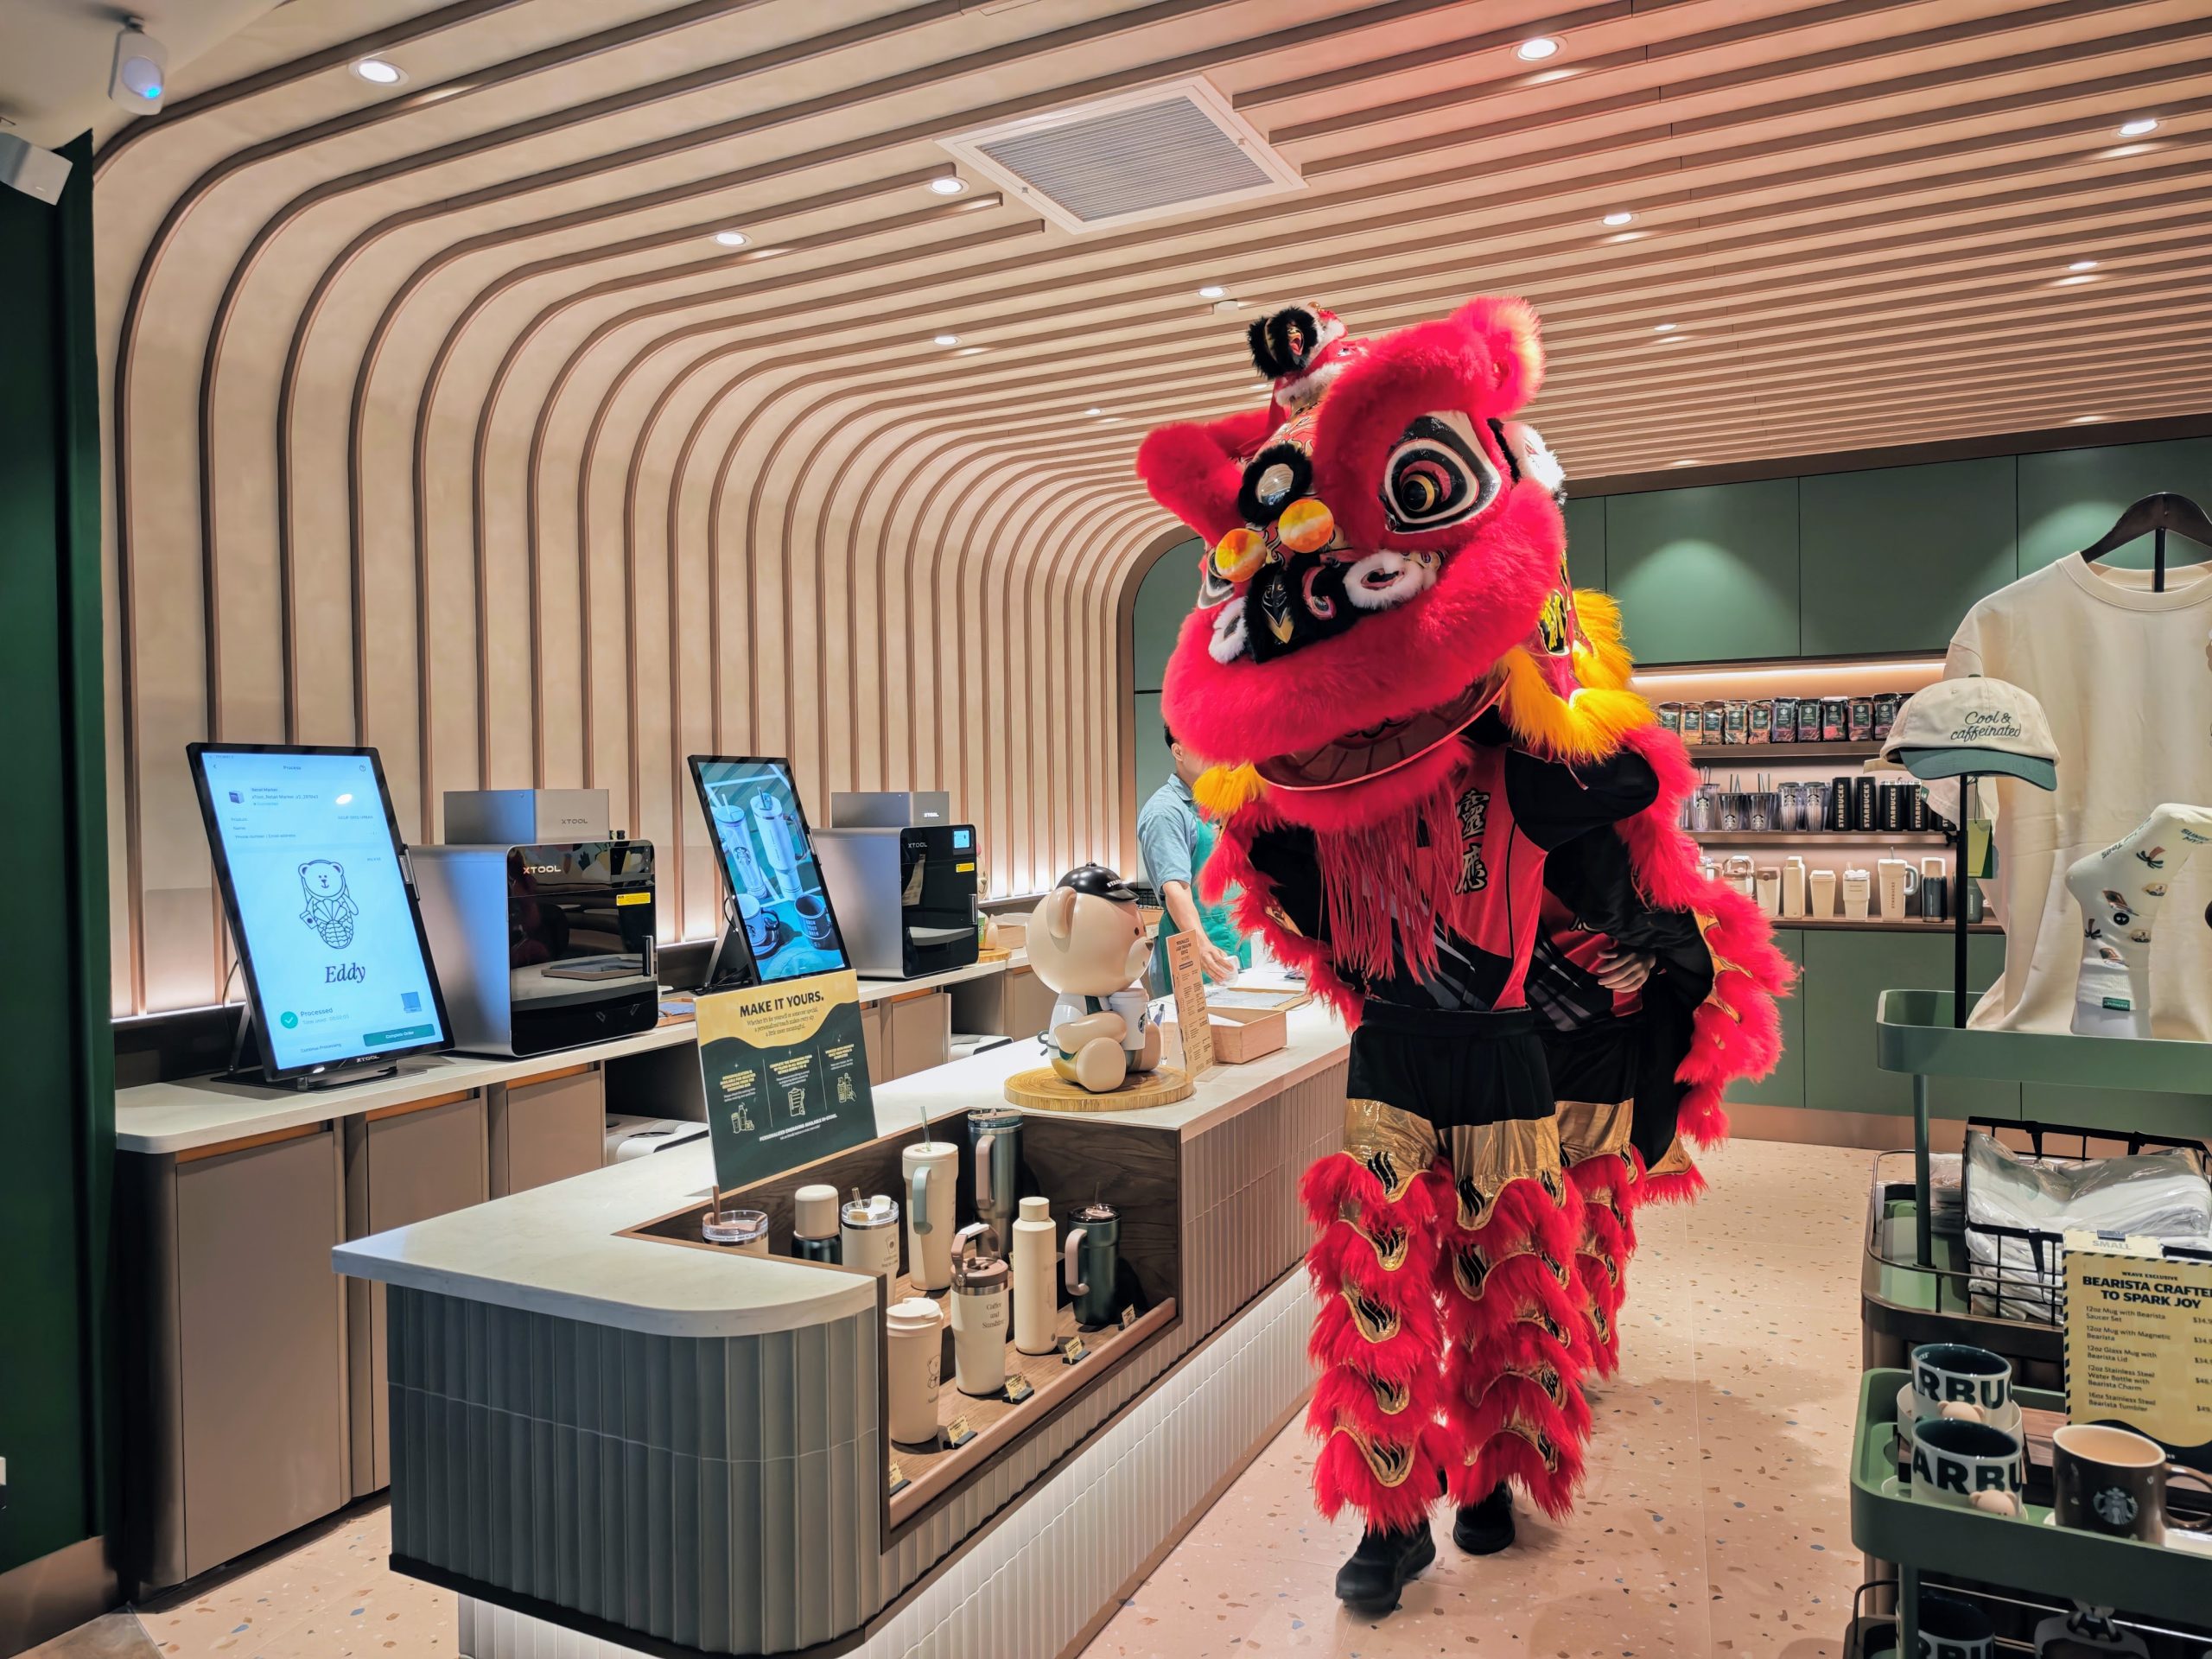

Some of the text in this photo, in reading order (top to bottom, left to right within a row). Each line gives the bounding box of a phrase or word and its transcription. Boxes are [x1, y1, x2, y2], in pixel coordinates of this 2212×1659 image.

[1965, 710, 2012, 725] Cool &
[1950, 723, 2022, 742] caffeinated
[523, 865, 562, 874] XTOOL
[325, 962, 365, 983] Eddy
[740, 991, 824, 1018] MAKE IT YOURS.
[301, 1007, 334, 1017] Processed
[2092, 1240, 2132, 1250] SMALL
[2082, 1275, 2212, 1299] BEARISTA CRAFTE
[2101, 1289, 2202, 1309] TO SPARK JOY
[2102, 1307, 2118, 1316] Mug
[2137, 1312, 2166, 1320] Bearista
[2087, 1332, 2115, 1341] Bearista
[2137, 1332, 2171, 1340] Magnetic
[2088, 1352, 2115, 1361] Bearista
[2124, 1349, 2139, 1357] Mug
[2104, 1367, 2136, 1376] Stainless
[2088, 1380, 2116, 1389] Bearista
[2105, 1394, 2137, 1403] Stainless
[2088, 1400, 2117, 1408] Bearista
